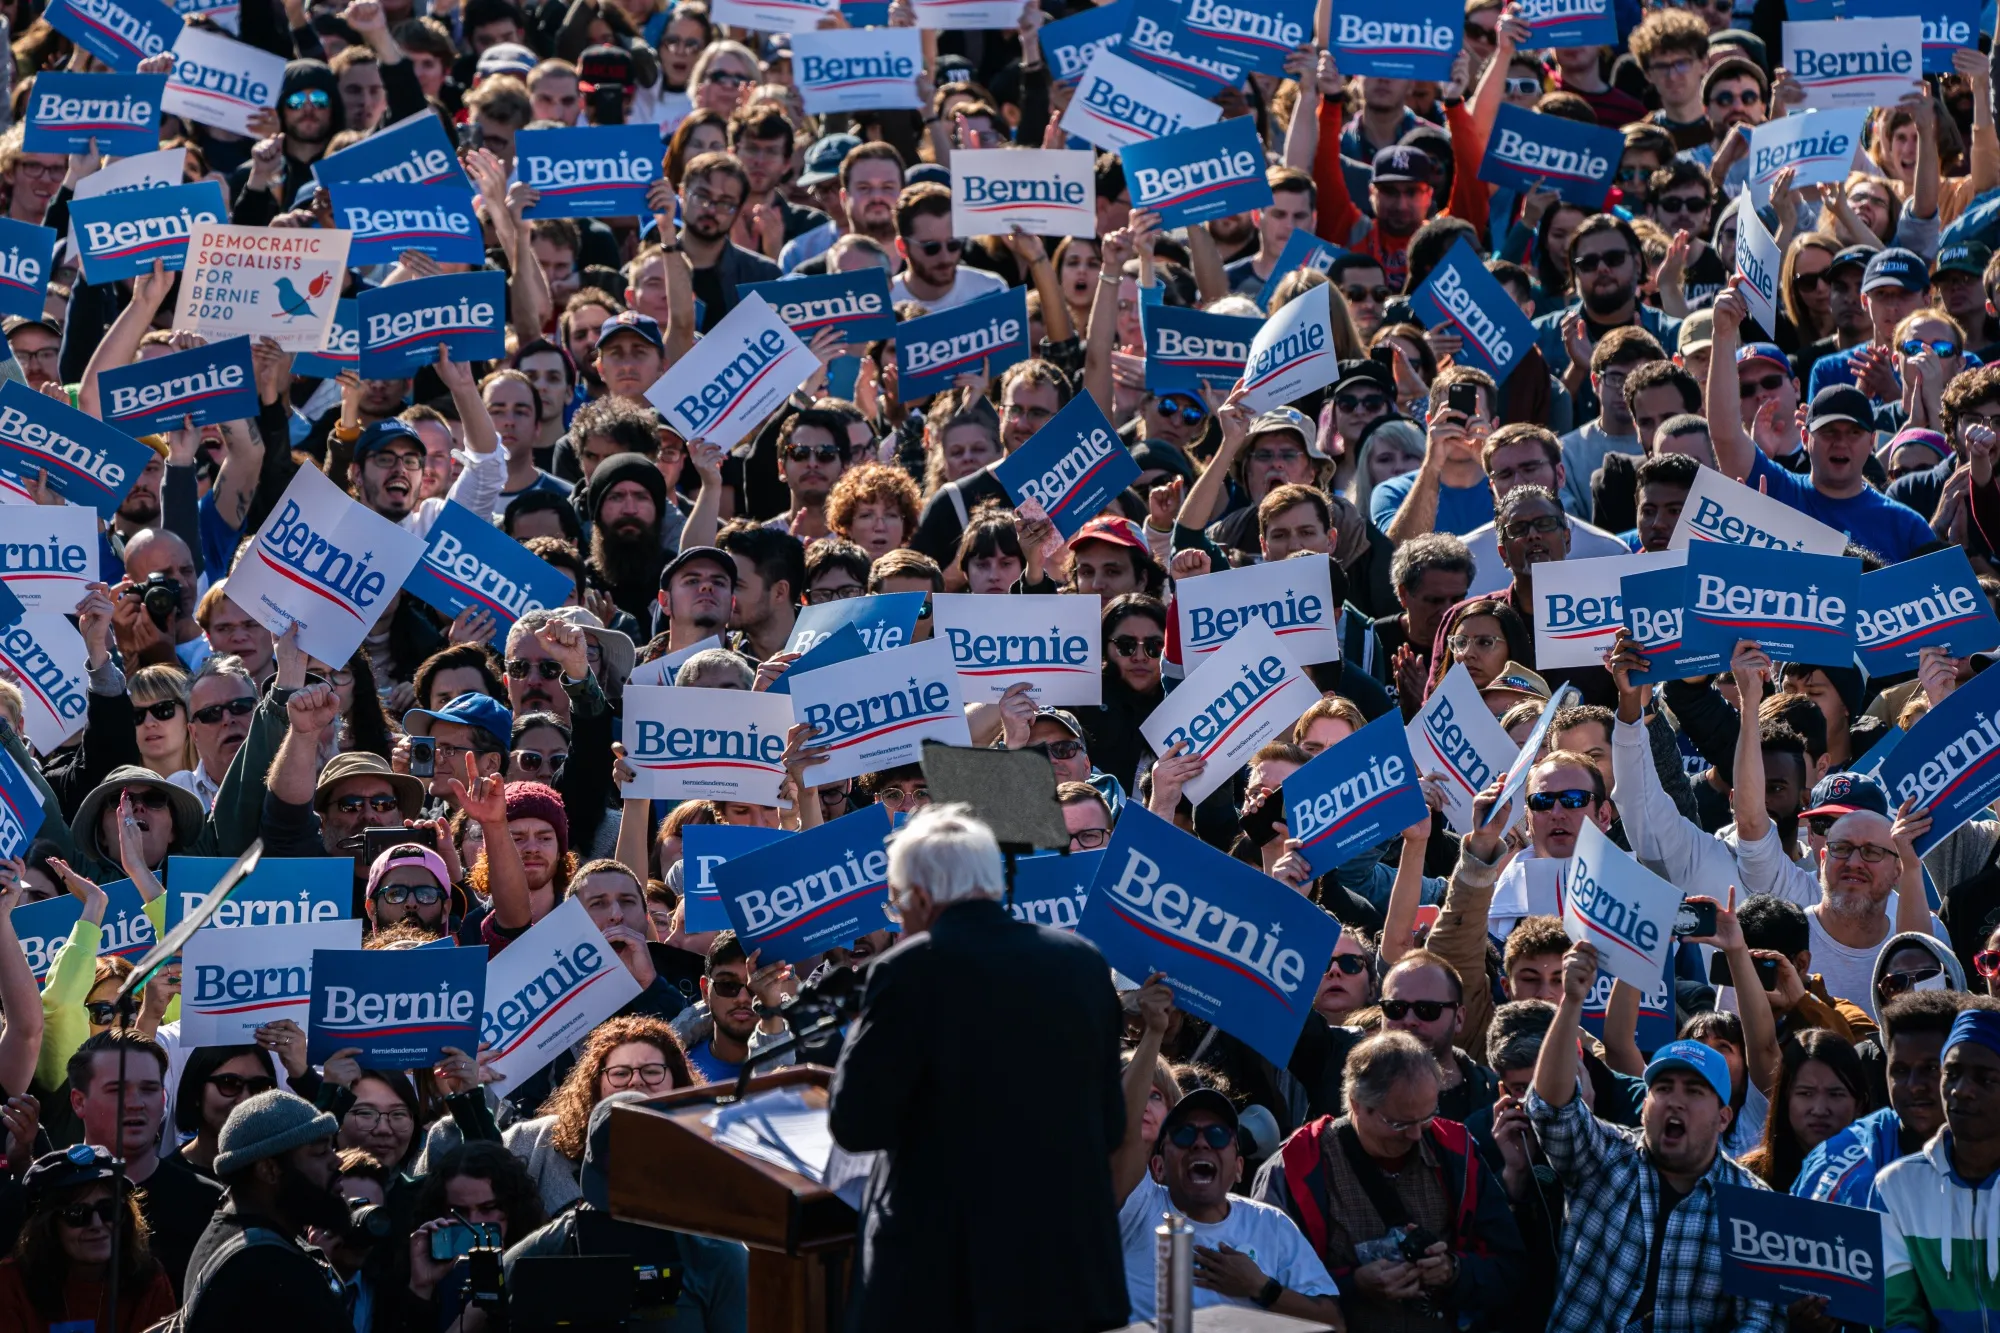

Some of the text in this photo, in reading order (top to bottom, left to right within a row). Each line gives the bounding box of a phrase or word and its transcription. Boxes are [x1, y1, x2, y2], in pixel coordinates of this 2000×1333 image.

[1187, 0, 1302, 46] Bernie
[1338, 15, 1453, 49] Bernie
[802, 51, 913, 83] Bernie
[1794, 42, 1913, 77] Bernie
[34, 94, 152, 125] Bernie
[527, 150, 653, 186] Bernie
[1497, 128, 1609, 180] Bernie
[1756, 130, 1849, 173] Bernie
[963, 175, 1084, 204] Bernie
[1134, 147, 1256, 201] Bernie
[346, 204, 470, 236] Bernie
[198, 251, 302, 270] SOCIALISTS
[202, 233, 321, 253] DEMOCRATIC
[1737, 220, 1772, 299] Bernie
[191, 286, 260, 304] BERNIE
[195, 269, 233, 285] FOR
[187, 303, 233, 320] 2020
[366, 297, 494, 345] Bernie
[770, 290, 882, 327] ernie
[1433, 263, 1513, 367] Bernie
[905, 318, 1020, 372] Bernie
[1156, 329, 1248, 360] Bern
[110, 363, 243, 415] Bernie
[674, 329, 785, 430] Bernie
[0, 405, 126, 488] Bernie
[1018, 428, 1113, 508] Bernie
[0, 534, 87, 573] rnie
[265, 498, 386, 608] Bernie
[1189, 588, 1322, 642] Bernie
[1547, 593, 1622, 627] Ber
[1696, 574, 1846, 628] Bernie
[1855, 584, 1976, 640] Bernie
[794, 619, 902, 654] Benie
[945, 624, 1089, 664] Bernie
[1631, 606, 1684, 644] Ber
[804, 676, 949, 739] Bernie
[1163, 654, 1286, 756] Bernie
[635, 720, 785, 763] Bernie
[860, 743, 913, 759] BernieSanders.com
[1227, 720, 1271, 758] BernieSanders.com
[682, 780, 739, 788] BernieSanders.com
[1293, 755, 1405, 840] Bernie
[181, 889, 340, 930] Bernie
[735, 849, 887, 932] Bernie
[1572, 857, 1659, 951] Bernie
[20, 910, 152, 970] Benie
[803, 917, 858, 943] BernieSanders.com
[1112, 847, 1305, 992] Bernie
[324, 981, 474, 1022] Bernie
[480, 942, 603, 1046] Bernie
[371, 1047, 428, 1055] BernieSanders.com
[537, 1012, 585, 1050] BernieSanders.com
[1730, 1217, 1873, 1281] Bernie
